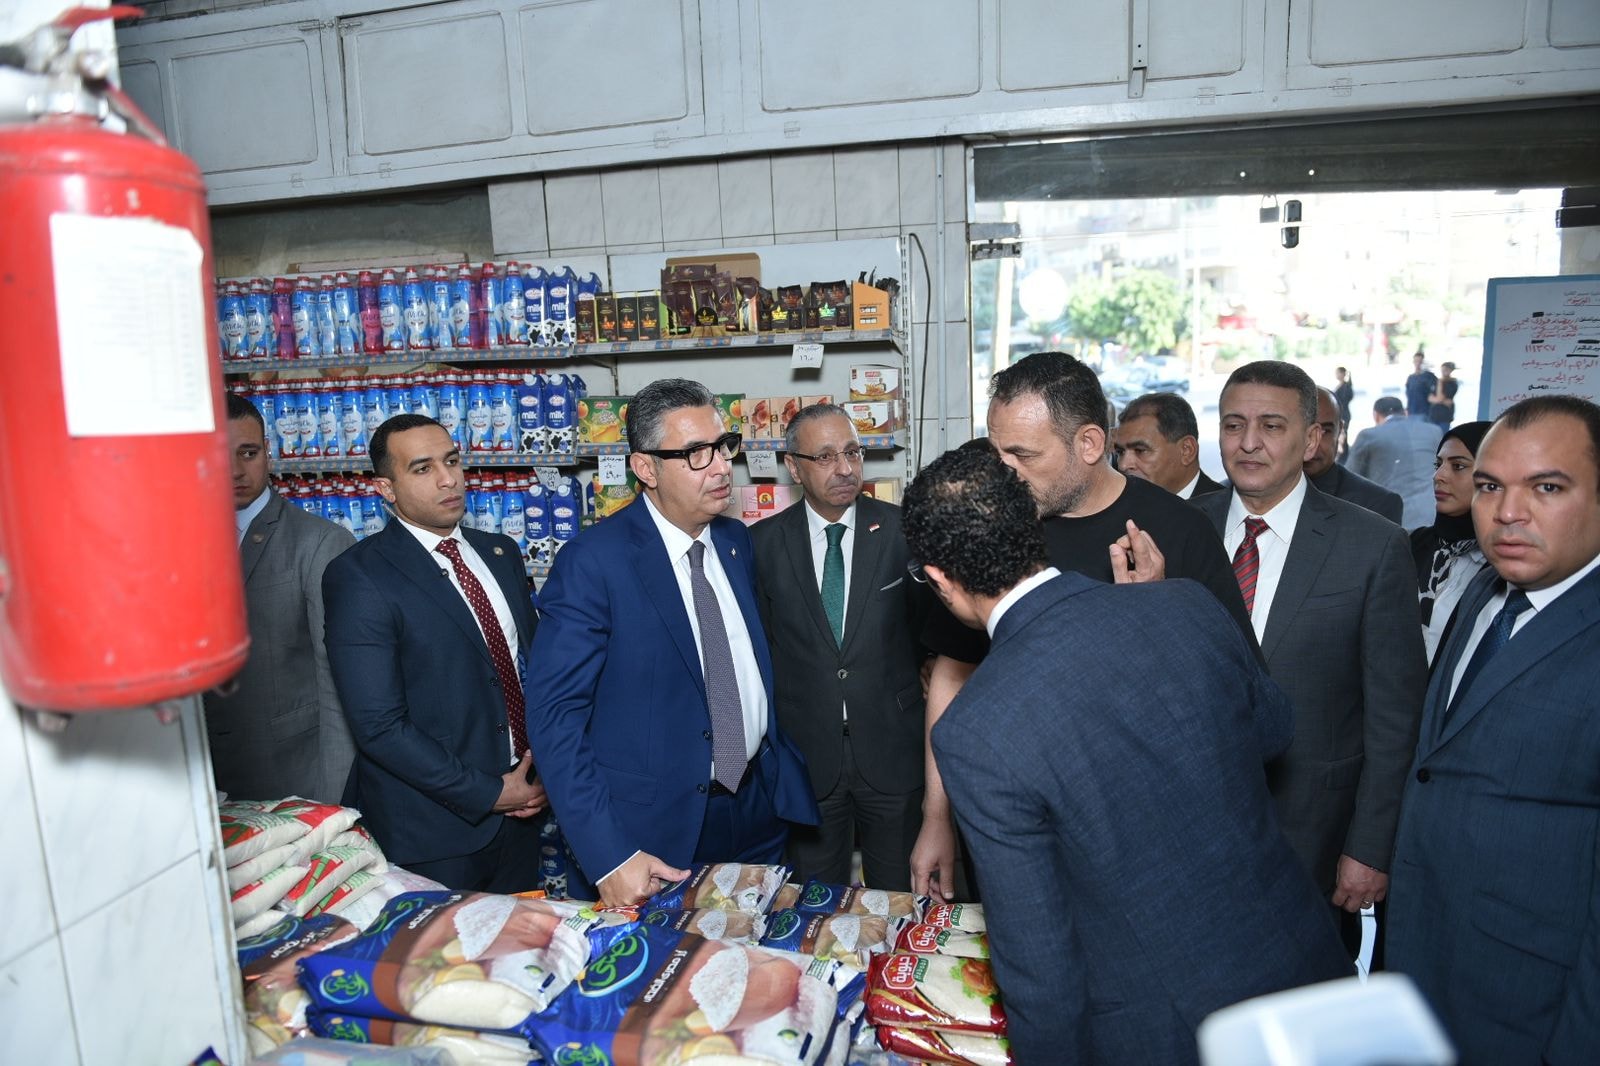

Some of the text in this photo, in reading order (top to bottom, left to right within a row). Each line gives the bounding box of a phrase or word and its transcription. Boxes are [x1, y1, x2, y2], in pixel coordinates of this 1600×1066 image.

[521, 411, 538, 420] milk
[549, 410, 565, 420] milk
[556, 522, 573, 531] milk
[916, 926, 936, 947] حبوبة
[892, 956, 913, 983] حبوبة
